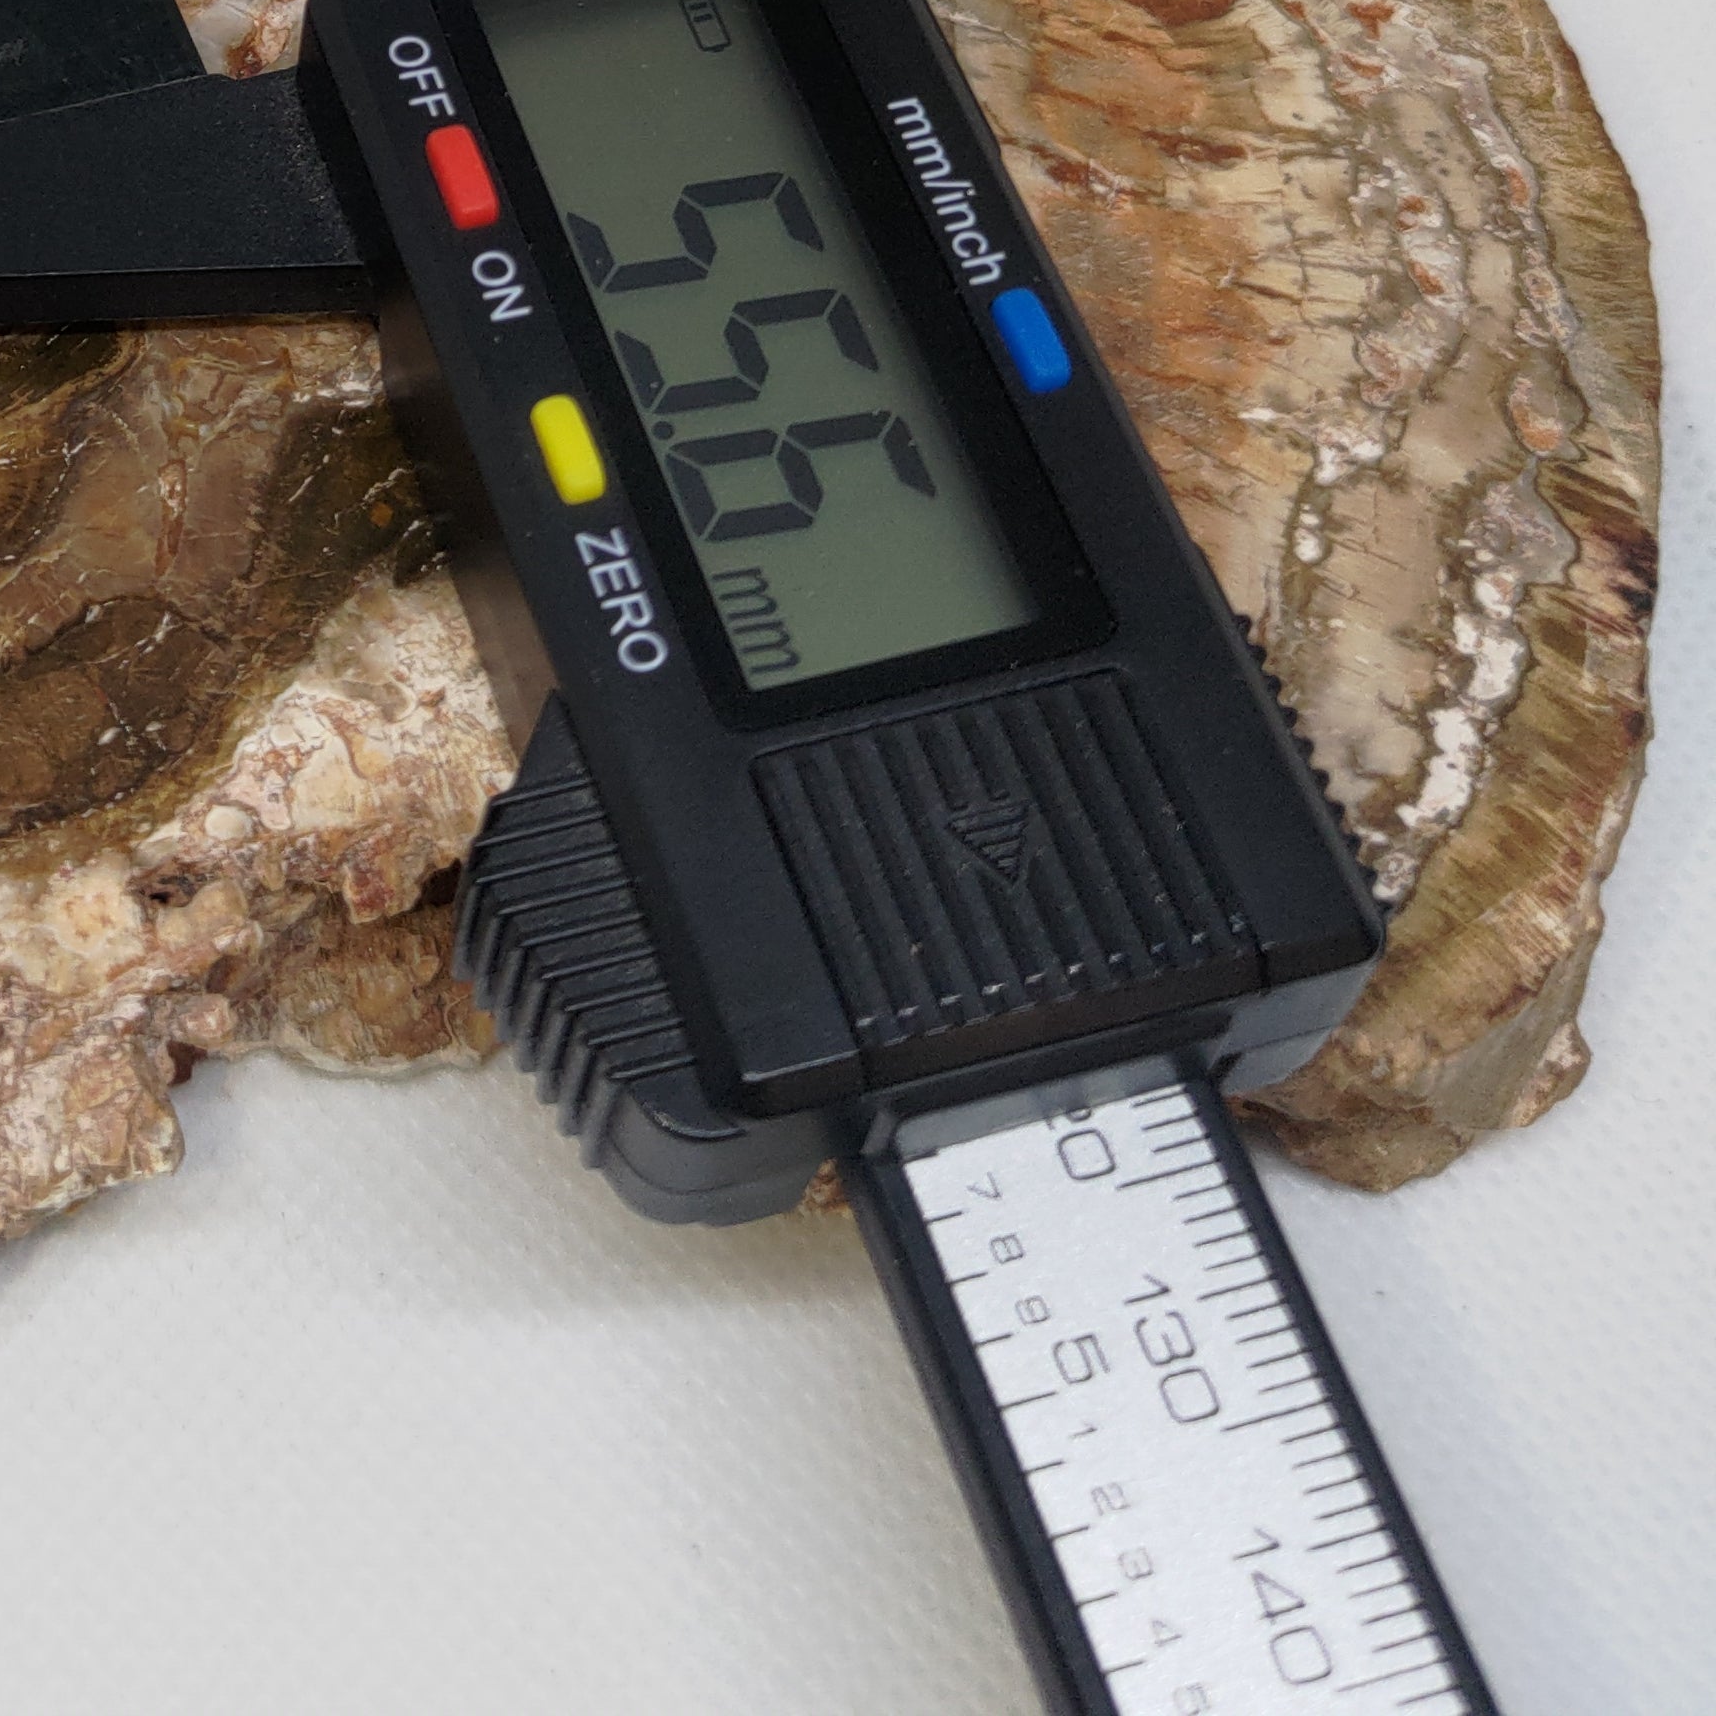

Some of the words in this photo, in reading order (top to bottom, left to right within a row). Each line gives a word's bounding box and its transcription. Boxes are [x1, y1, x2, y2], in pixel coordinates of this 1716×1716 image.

[387, 35, 456, 118] OFF
[886, 97, 1009, 287] mm/inch
[471, 249, 534, 323] ON
[566, 171, 938, 542] 55.6
[574, 526, 669, 674] ZERO
[711, 567, 800, 675] mm
[990, 1233, 1025, 1264] 8
[1052, 1333, 1110, 1384] 5
[1124, 1273, 1220, 1423] 130
[1232, 1528, 1332, 1685] 140
